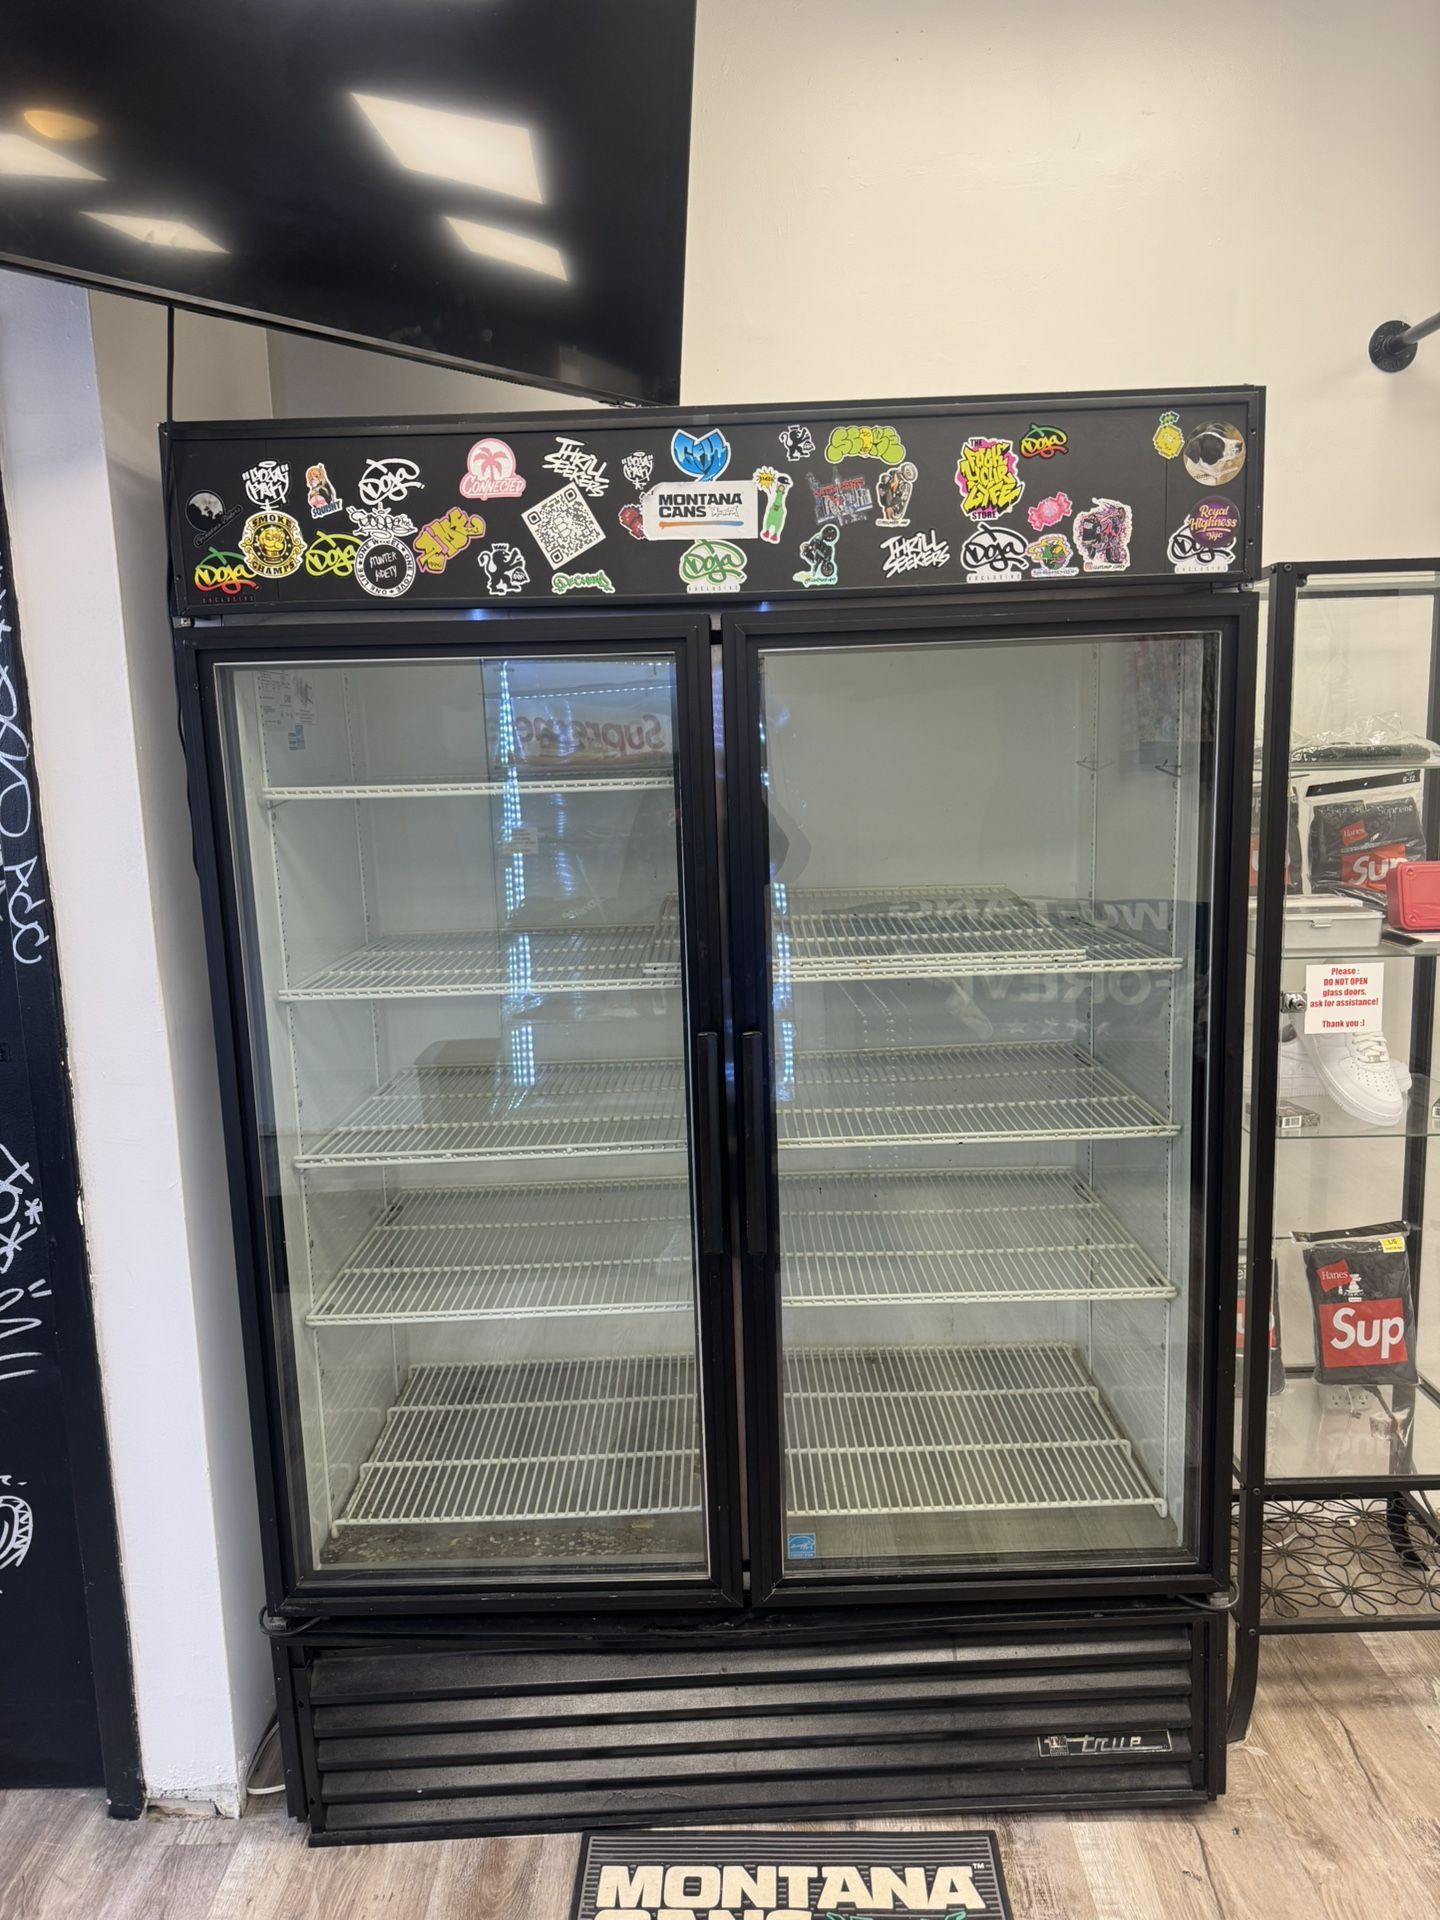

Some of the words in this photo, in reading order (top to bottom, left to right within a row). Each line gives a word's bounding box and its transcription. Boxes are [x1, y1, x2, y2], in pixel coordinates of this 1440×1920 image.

[658, 493, 742, 505] MONTANA
[658, 506, 707, 518] CANS
[972, 511, 997, 519] STORE
[1199, 505, 1229, 519] Royal
[252, 514, 294, 527] SMOKE
[252, 561, 295, 574] CHAMPS
[1323, 978, 1333, 986] DO
[1350, 977, 1368, 985] OPEN
[1322, 989, 1342, 997] glass
[1325, 999, 1334, 1007] for
[1322, 1020, 1344, 1028] Thank
[1346, 1020, 1358, 1028] you
[1321, 1270, 1349, 1280] Hanes
[1330, 1307, 1404, 1359] Sup
[596, 1864, 987, 1910] MONTANA
